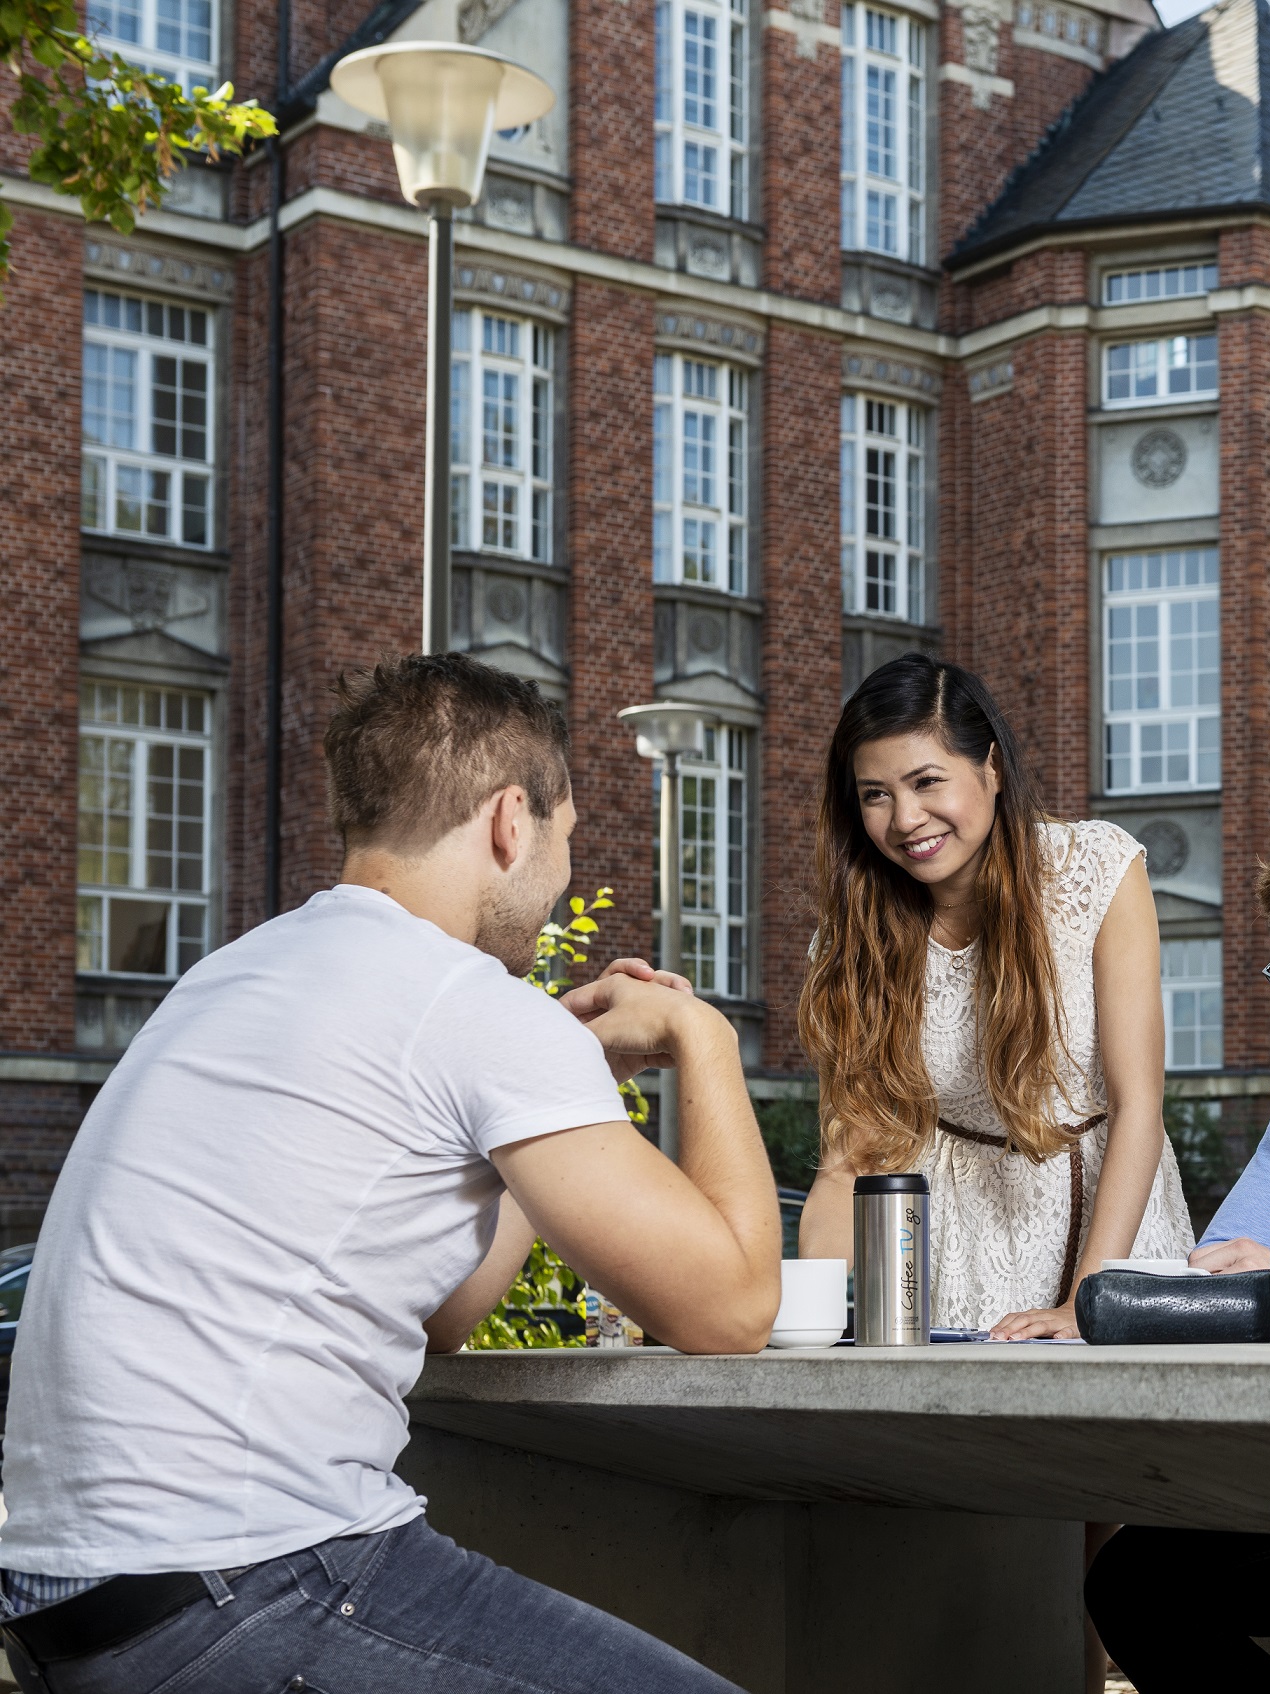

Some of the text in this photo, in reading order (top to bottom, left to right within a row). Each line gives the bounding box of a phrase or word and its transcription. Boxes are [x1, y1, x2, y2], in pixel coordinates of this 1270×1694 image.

[906, 1207, 921, 1225] go
[900, 1228, 913, 1255] TU
[901, 1260, 918, 1311] Coffee
